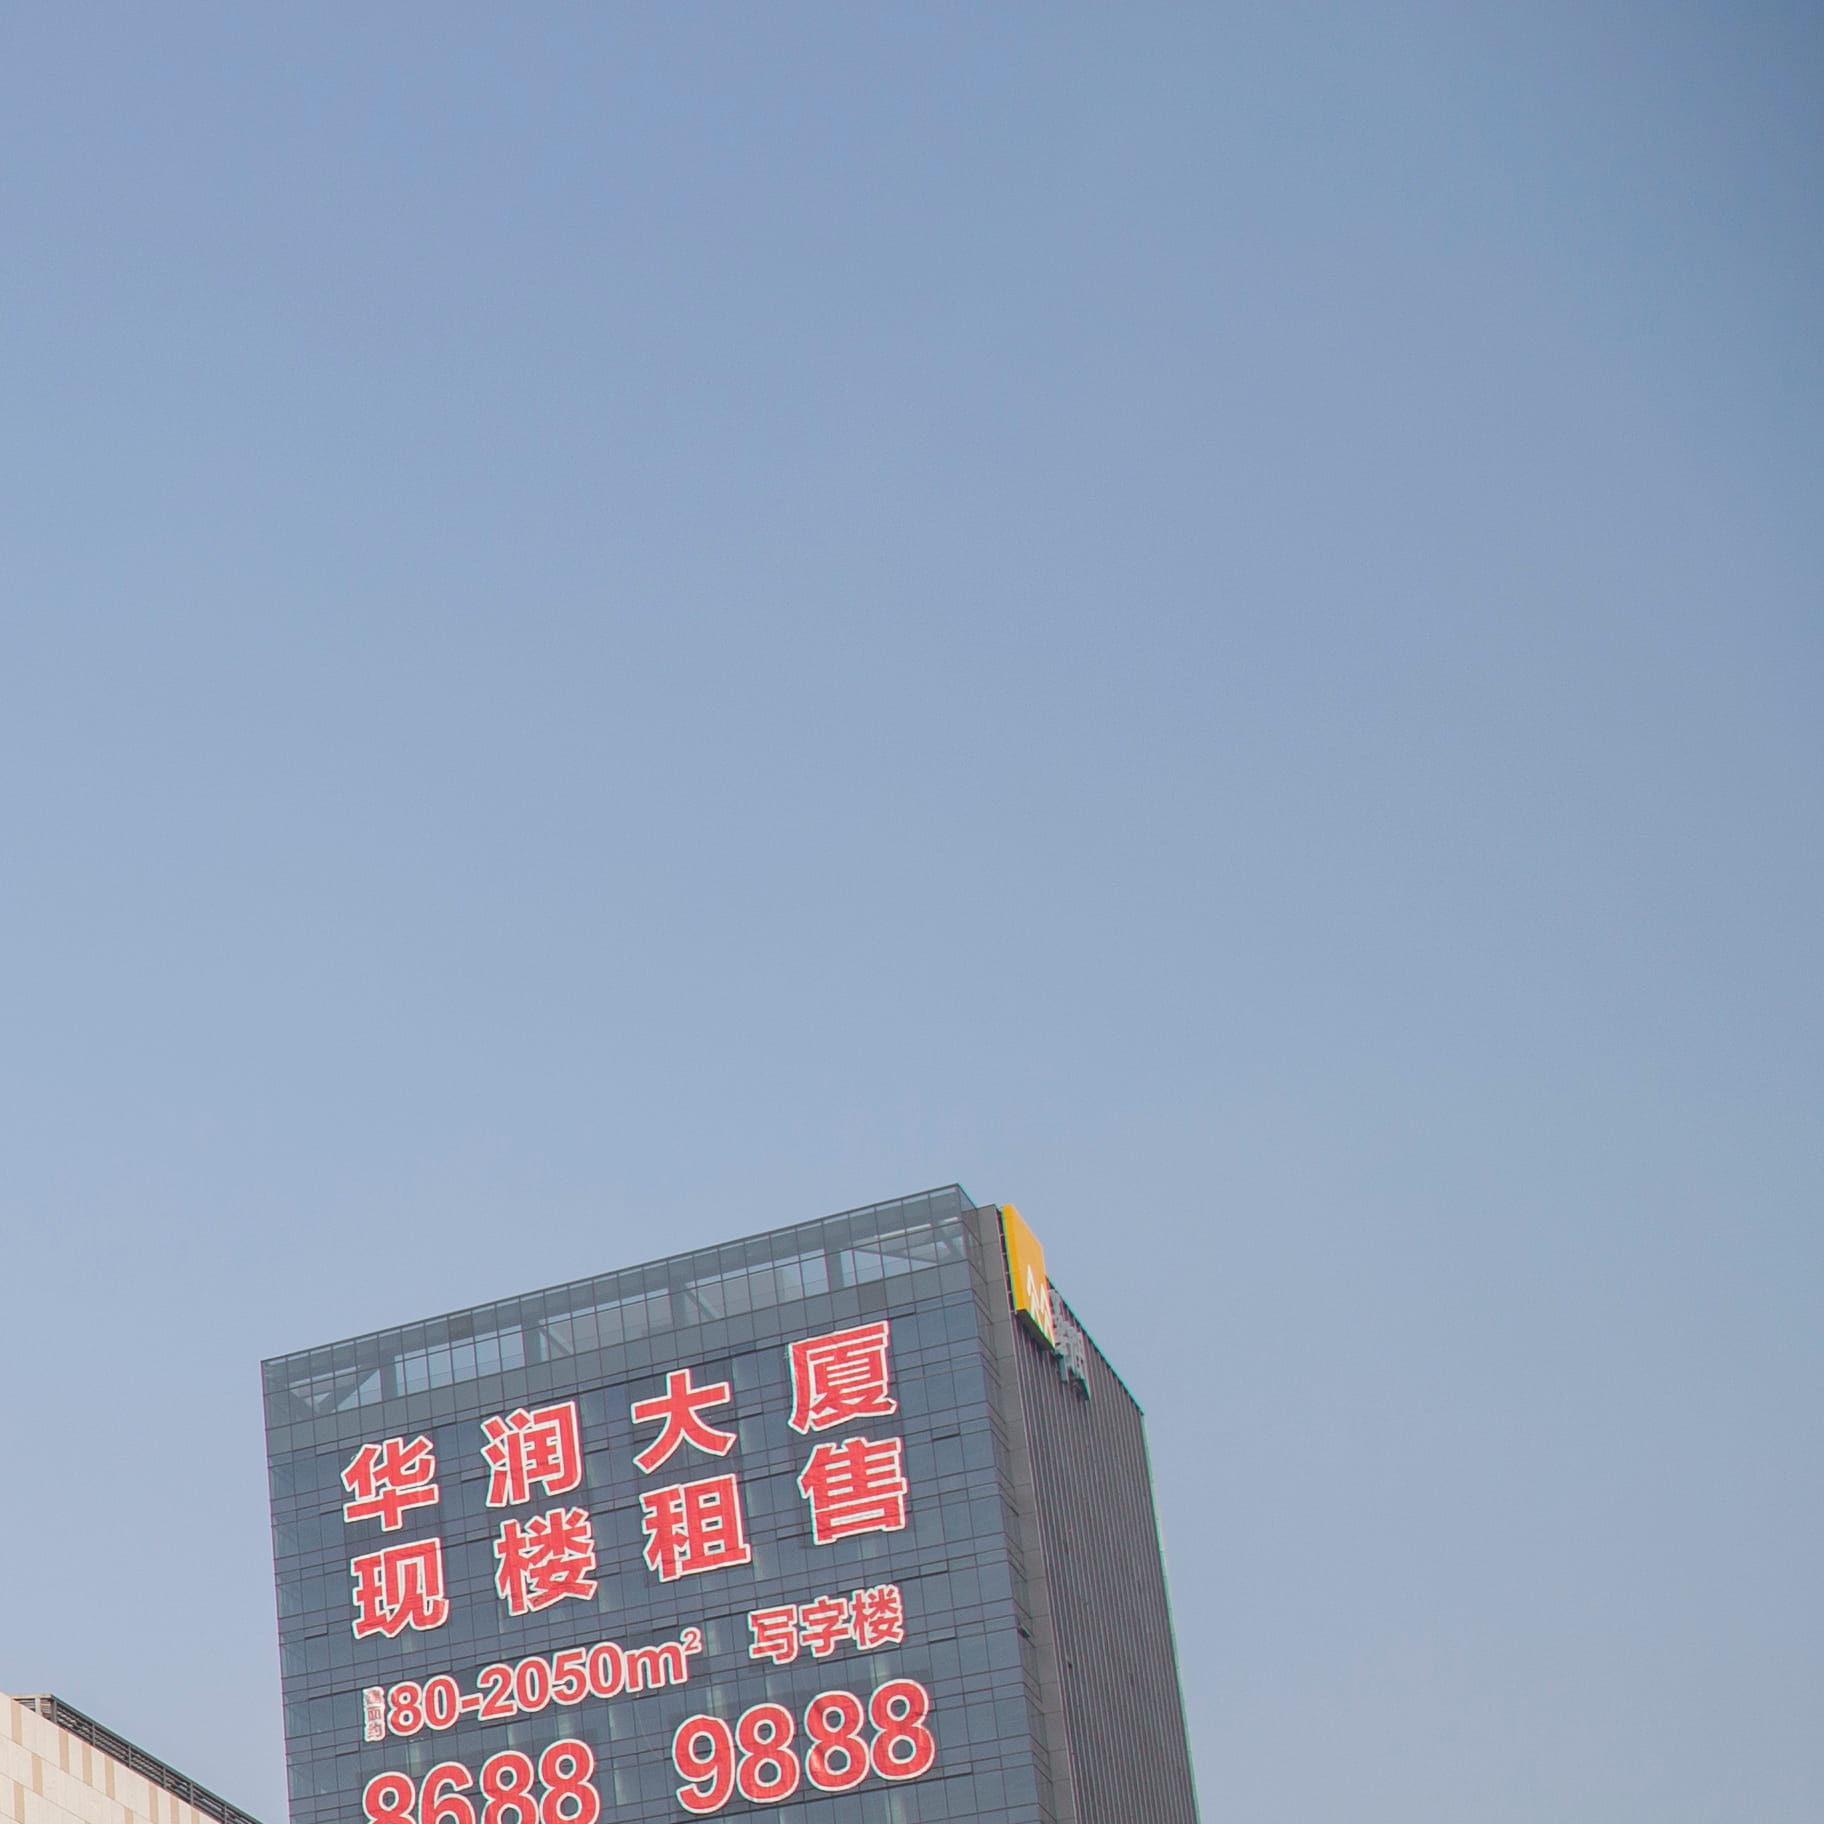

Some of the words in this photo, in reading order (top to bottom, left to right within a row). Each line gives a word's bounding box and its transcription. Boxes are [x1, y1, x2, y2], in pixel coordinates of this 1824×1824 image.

[341, 1320, 899, 1532] 华润大厦
[350, 1435, 908, 1640] 现楼租售
[748, 1584, 904, 1664] 写字楼
[672, 1678, 936, 1815] 9888
